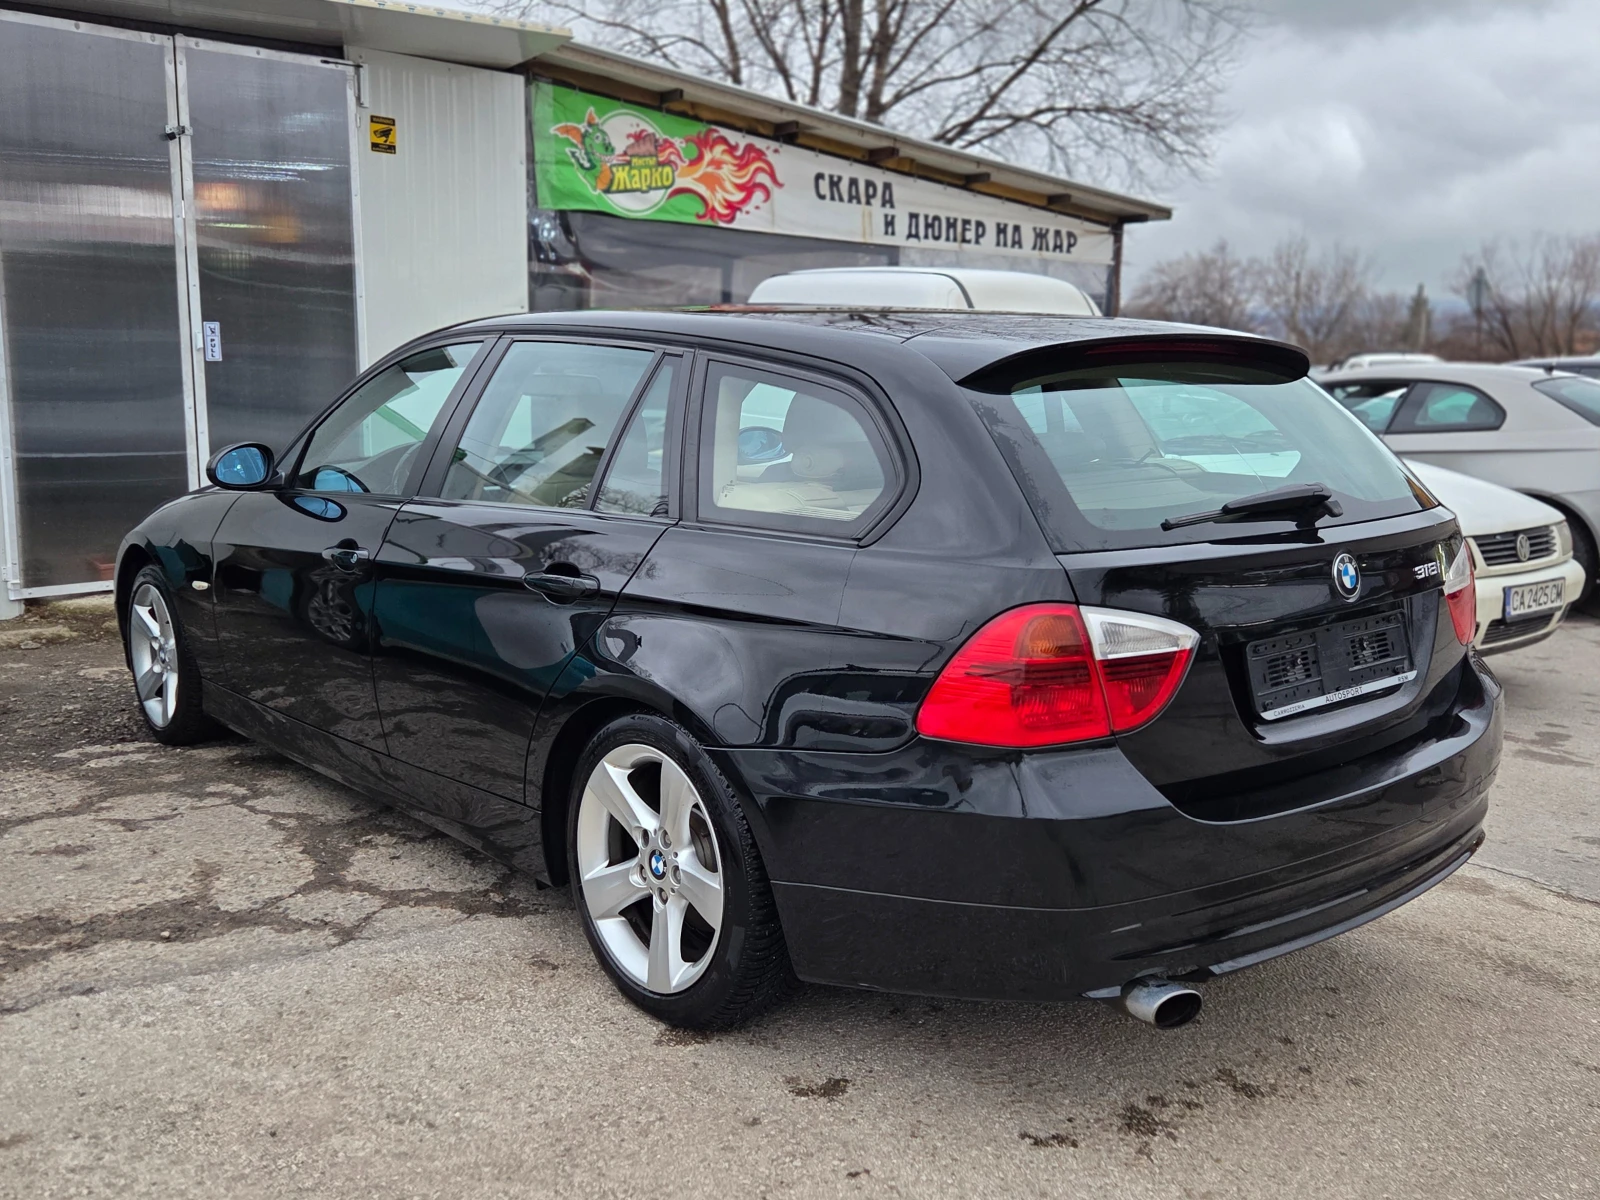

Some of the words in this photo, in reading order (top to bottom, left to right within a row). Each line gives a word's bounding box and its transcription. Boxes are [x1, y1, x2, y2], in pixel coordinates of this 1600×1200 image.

[610, 164, 673, 191] Жарко
[814, 172, 895, 209] СКАРА
[906, 212, 987, 245] ДЮНЕР
[995, 221, 1024, 250] НА
[1031, 226, 1078, 254] ЖАР
[1512, 590, 1525, 611] CA
[1527, 586, 1549, 609] 2425
[1551, 583, 1563, 604] CM
[1325, 686, 1363, 703] AUTOSPORT
